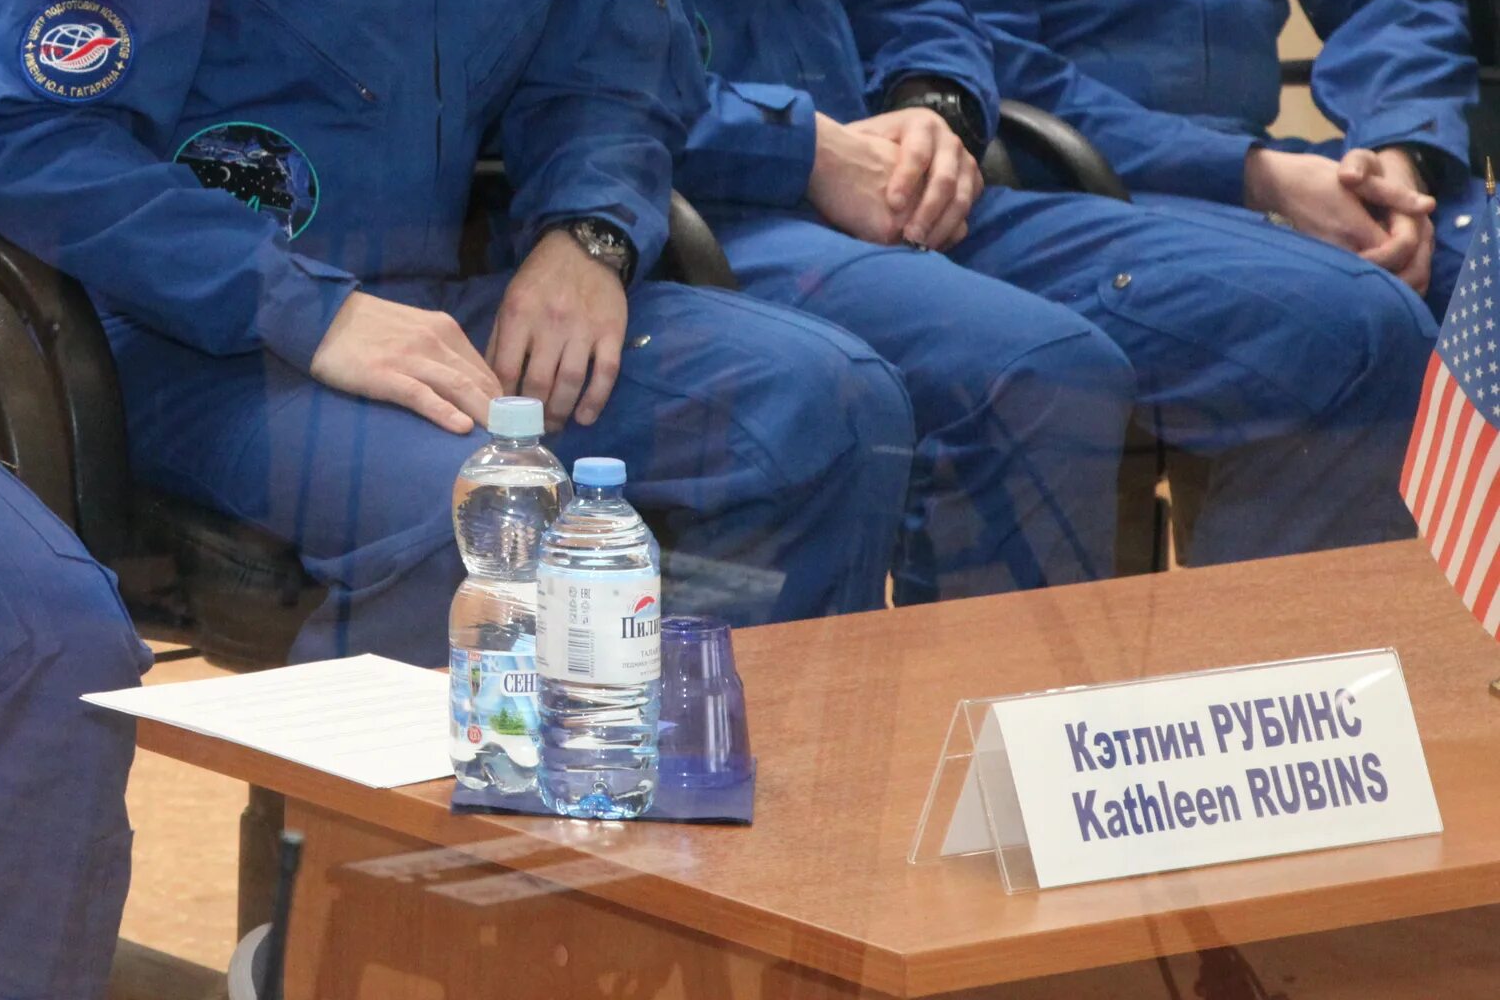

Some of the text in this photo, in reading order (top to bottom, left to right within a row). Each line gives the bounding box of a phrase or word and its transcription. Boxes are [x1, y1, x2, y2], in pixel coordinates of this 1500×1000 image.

[70, 70, 120, 97] ГАГАРИНА
[620, 616, 661, 640] Пили
[503, 672, 540, 694] СЕН
[1064, 688, 1363, 772] Кэтлин РУБИНС
[1071, 752, 1389, 842] Kathleen RUBINS
